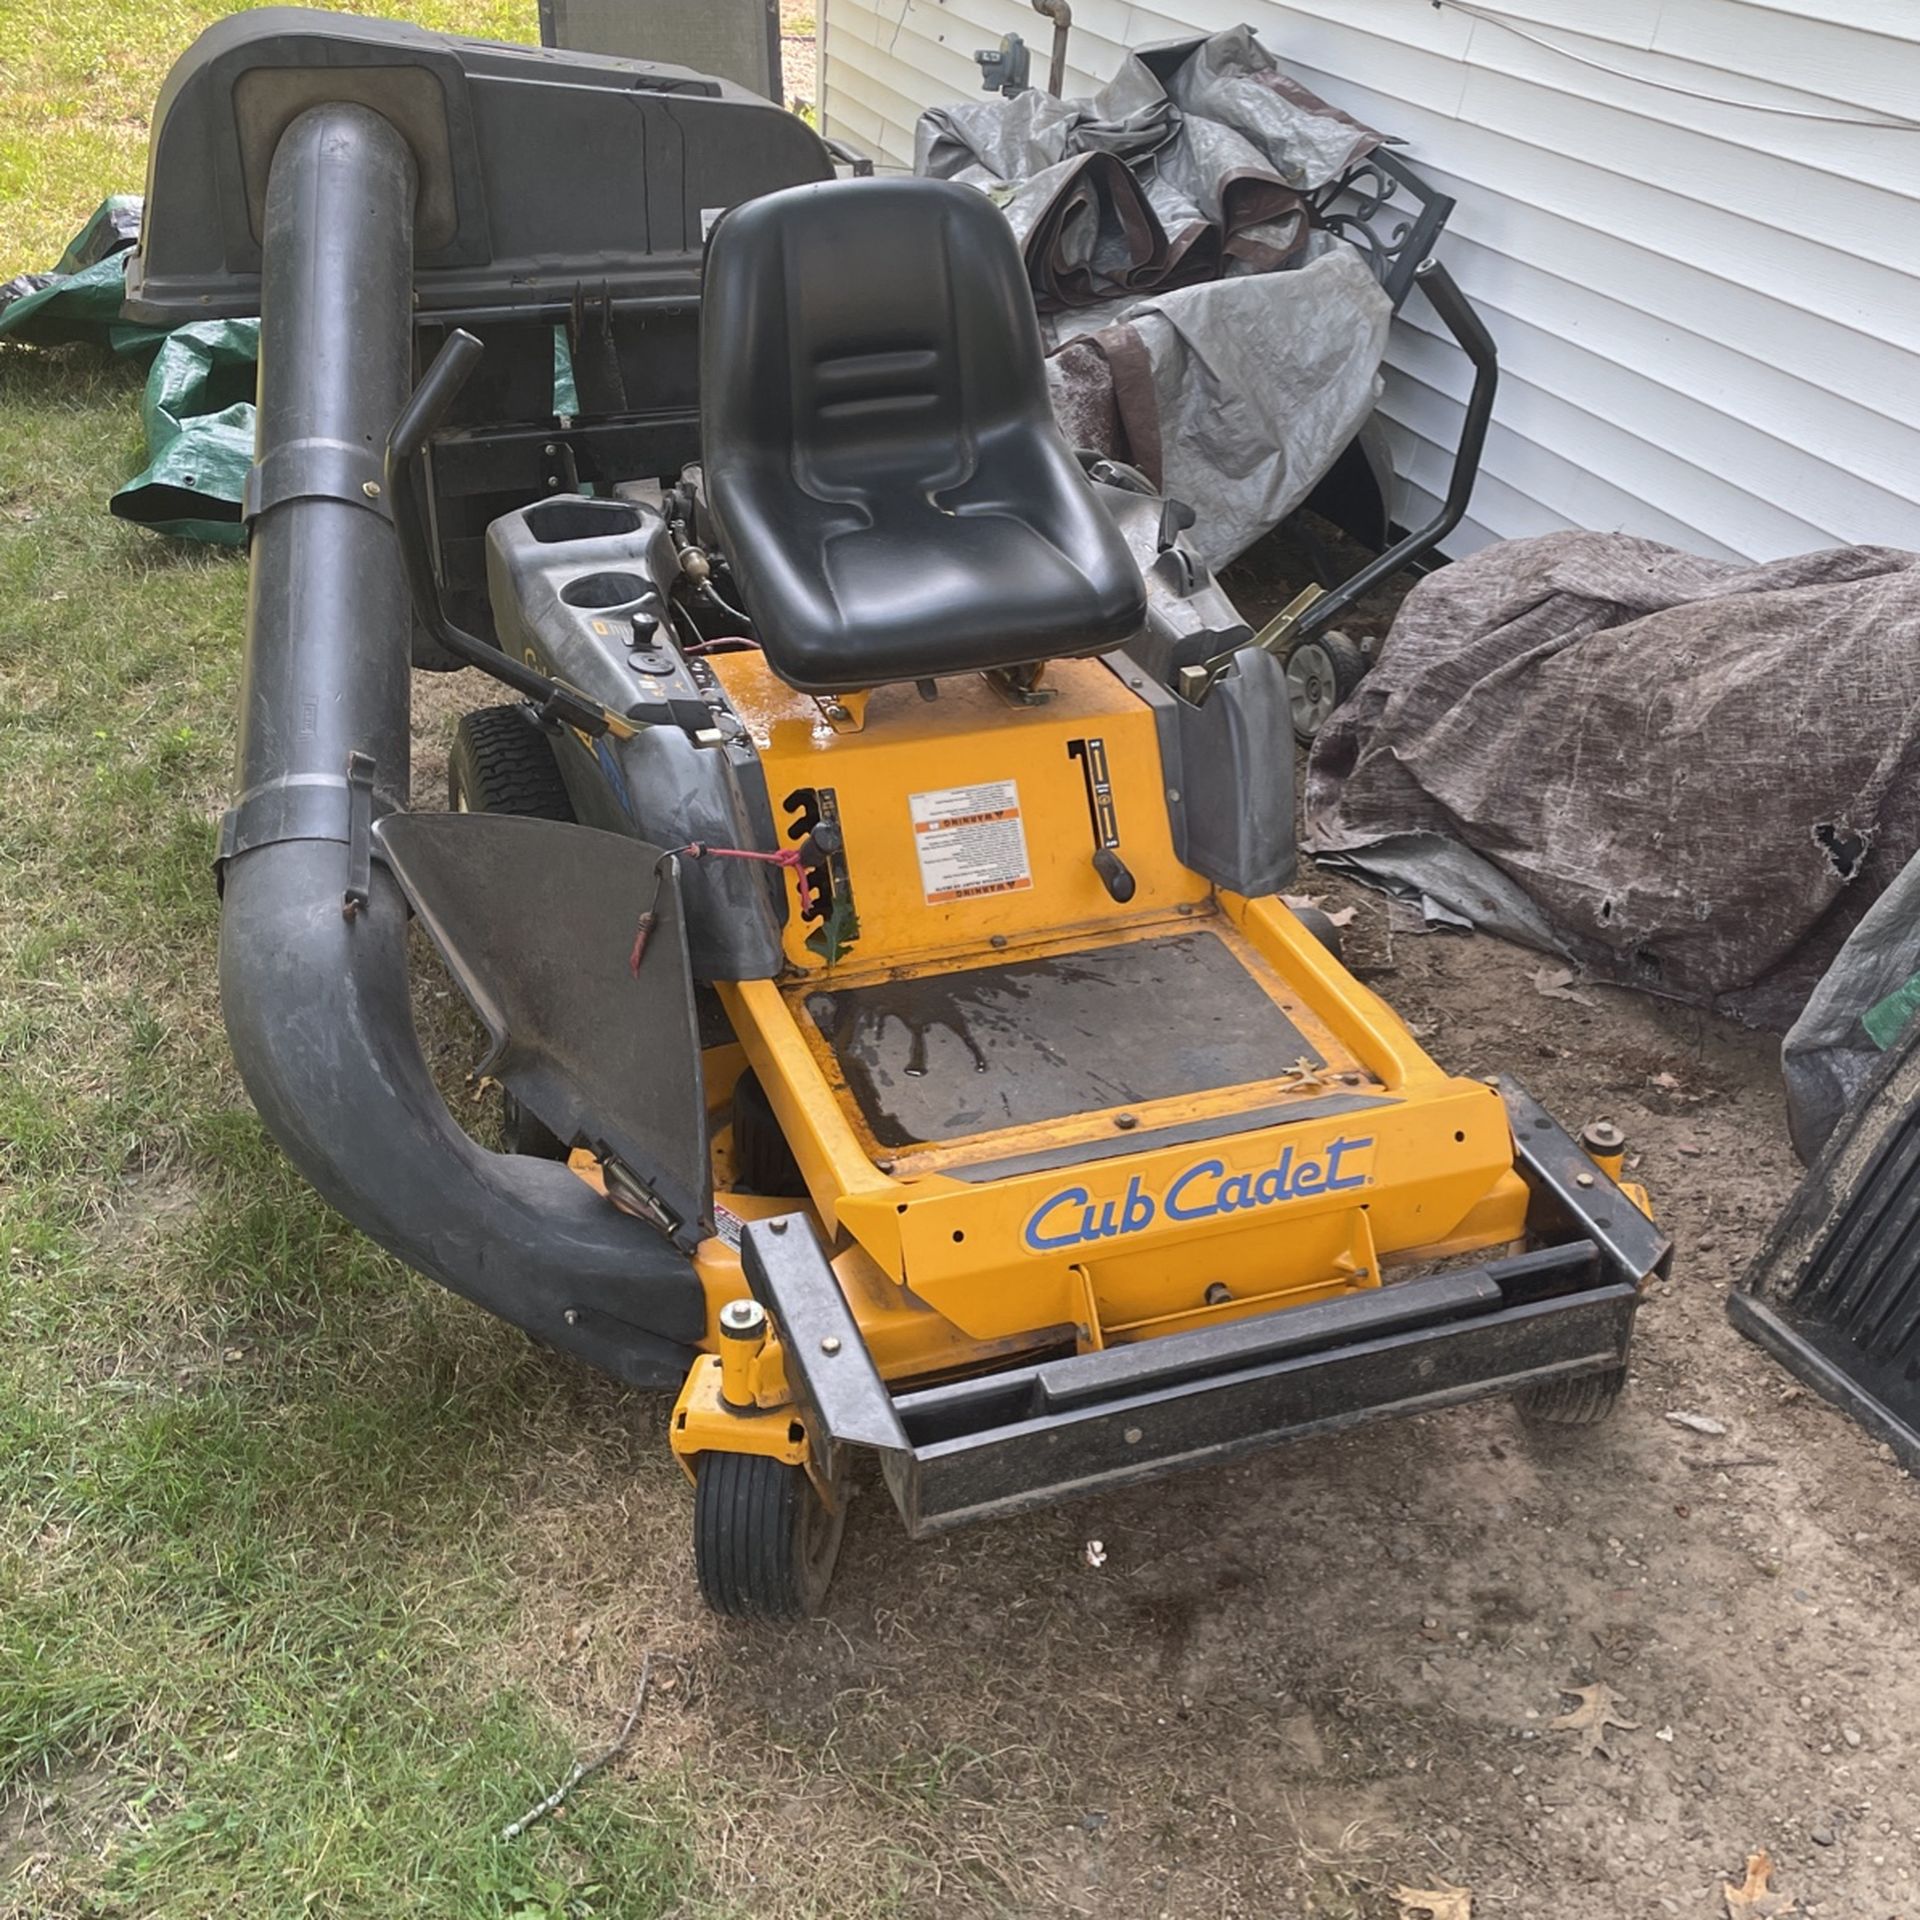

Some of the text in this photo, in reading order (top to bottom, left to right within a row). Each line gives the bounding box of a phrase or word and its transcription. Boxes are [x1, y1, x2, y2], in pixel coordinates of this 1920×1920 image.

[944, 813, 993, 827] WARNING
[956, 883, 1005, 898] WARNING
[1025, 1137, 1374, 1251] Cub Cadet
